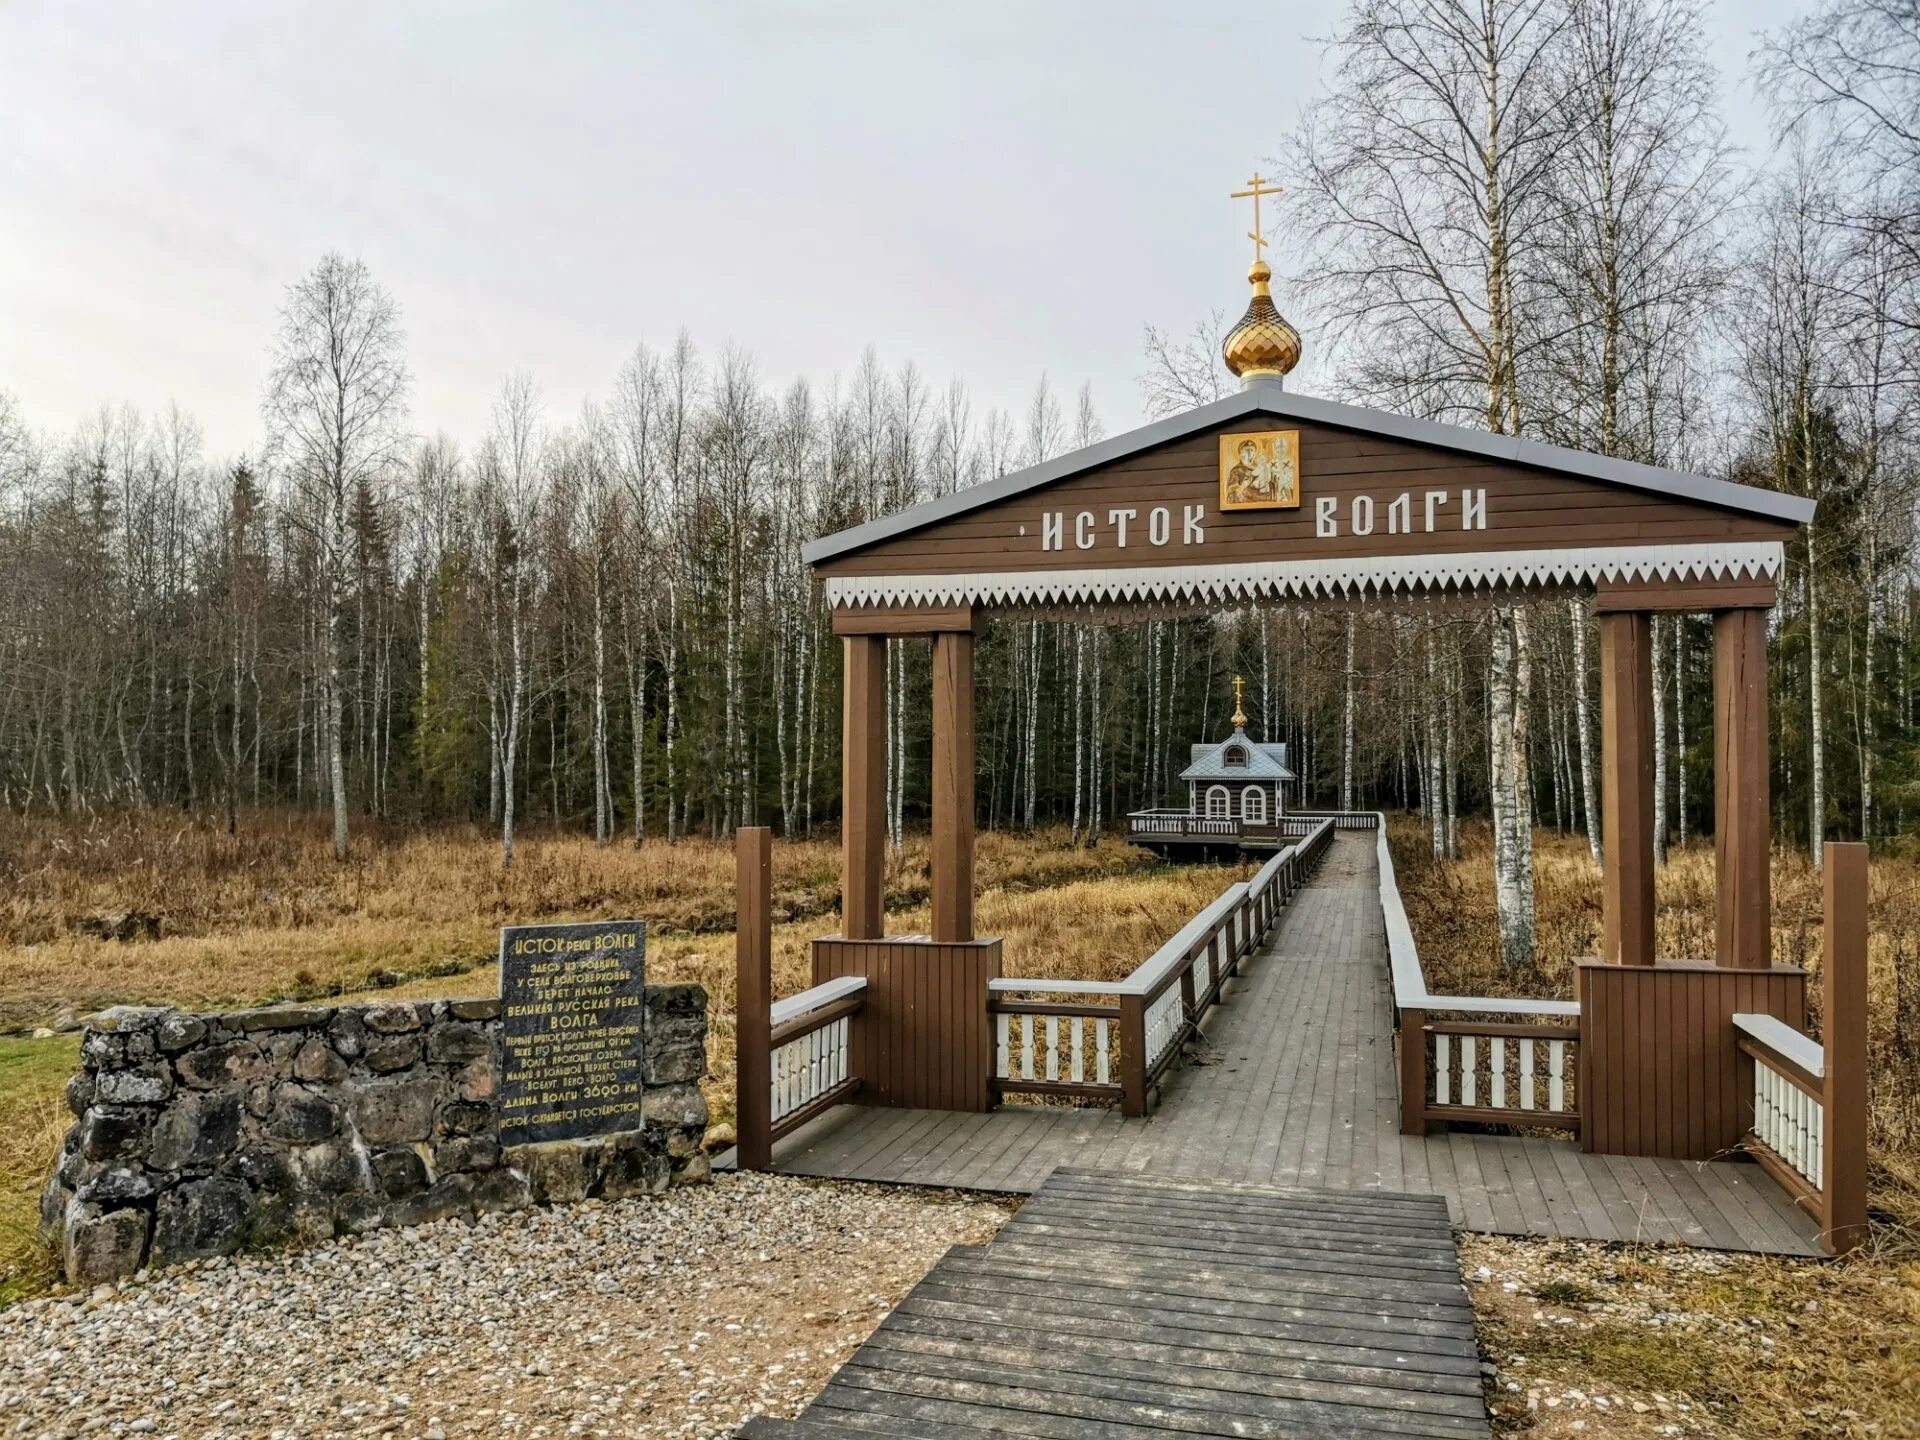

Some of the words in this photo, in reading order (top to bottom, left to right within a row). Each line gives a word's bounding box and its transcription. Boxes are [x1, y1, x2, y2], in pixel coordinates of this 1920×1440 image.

[1042, 504, 1205, 551] ИСТОК
[1315, 488, 1487, 537] ВОЛГИ
[515, 938, 563, 954] ИСТОК
[595, 933, 636, 949] ВОЛГИ
[530, 962, 560, 973] ЗДЕСЬ
[565, 961, 576, 971] ИЗ
[580, 958, 620, 970] РОДНИКА
[518, 978, 524, 987] У
[527, 977, 550, 988] СЕЛА
[554, 970, 631, 985] ВОЛГОВЕРХОВЬЕ
[537, 988, 569, 1000] БЕРЕТ
[575, 985, 612, 997] НАЧАЛО
[507, 1003, 553, 1017] ВЕЛИКАЯ
[559, 999, 610, 1012] РУССКАЯ
[615, 996, 639, 1007] РЕКА
[551, 1013, 598, 1029] ВОЛГА
[521, 1058, 547, 1069] ВОЛГА
[597, 1050, 623, 1060] ОЗЕРА
[535, 1045, 550, 1056] ЕГО
[553, 1045, 561, 1053] НА
[590, 1073, 617, 1084] ВОЛГО
[504, 1096, 538, 1108] ДЛИНА
[542, 1091, 577, 1103] ВОЛГИ
[584, 1084, 620, 1098] 3690
[501, 1116, 528, 1129] ИСТОК
[532, 1110, 576, 1124] ОХРАНЯЕТСЯ
[580, 1102, 640, 1117] ГОСУДАРСТВОМ
